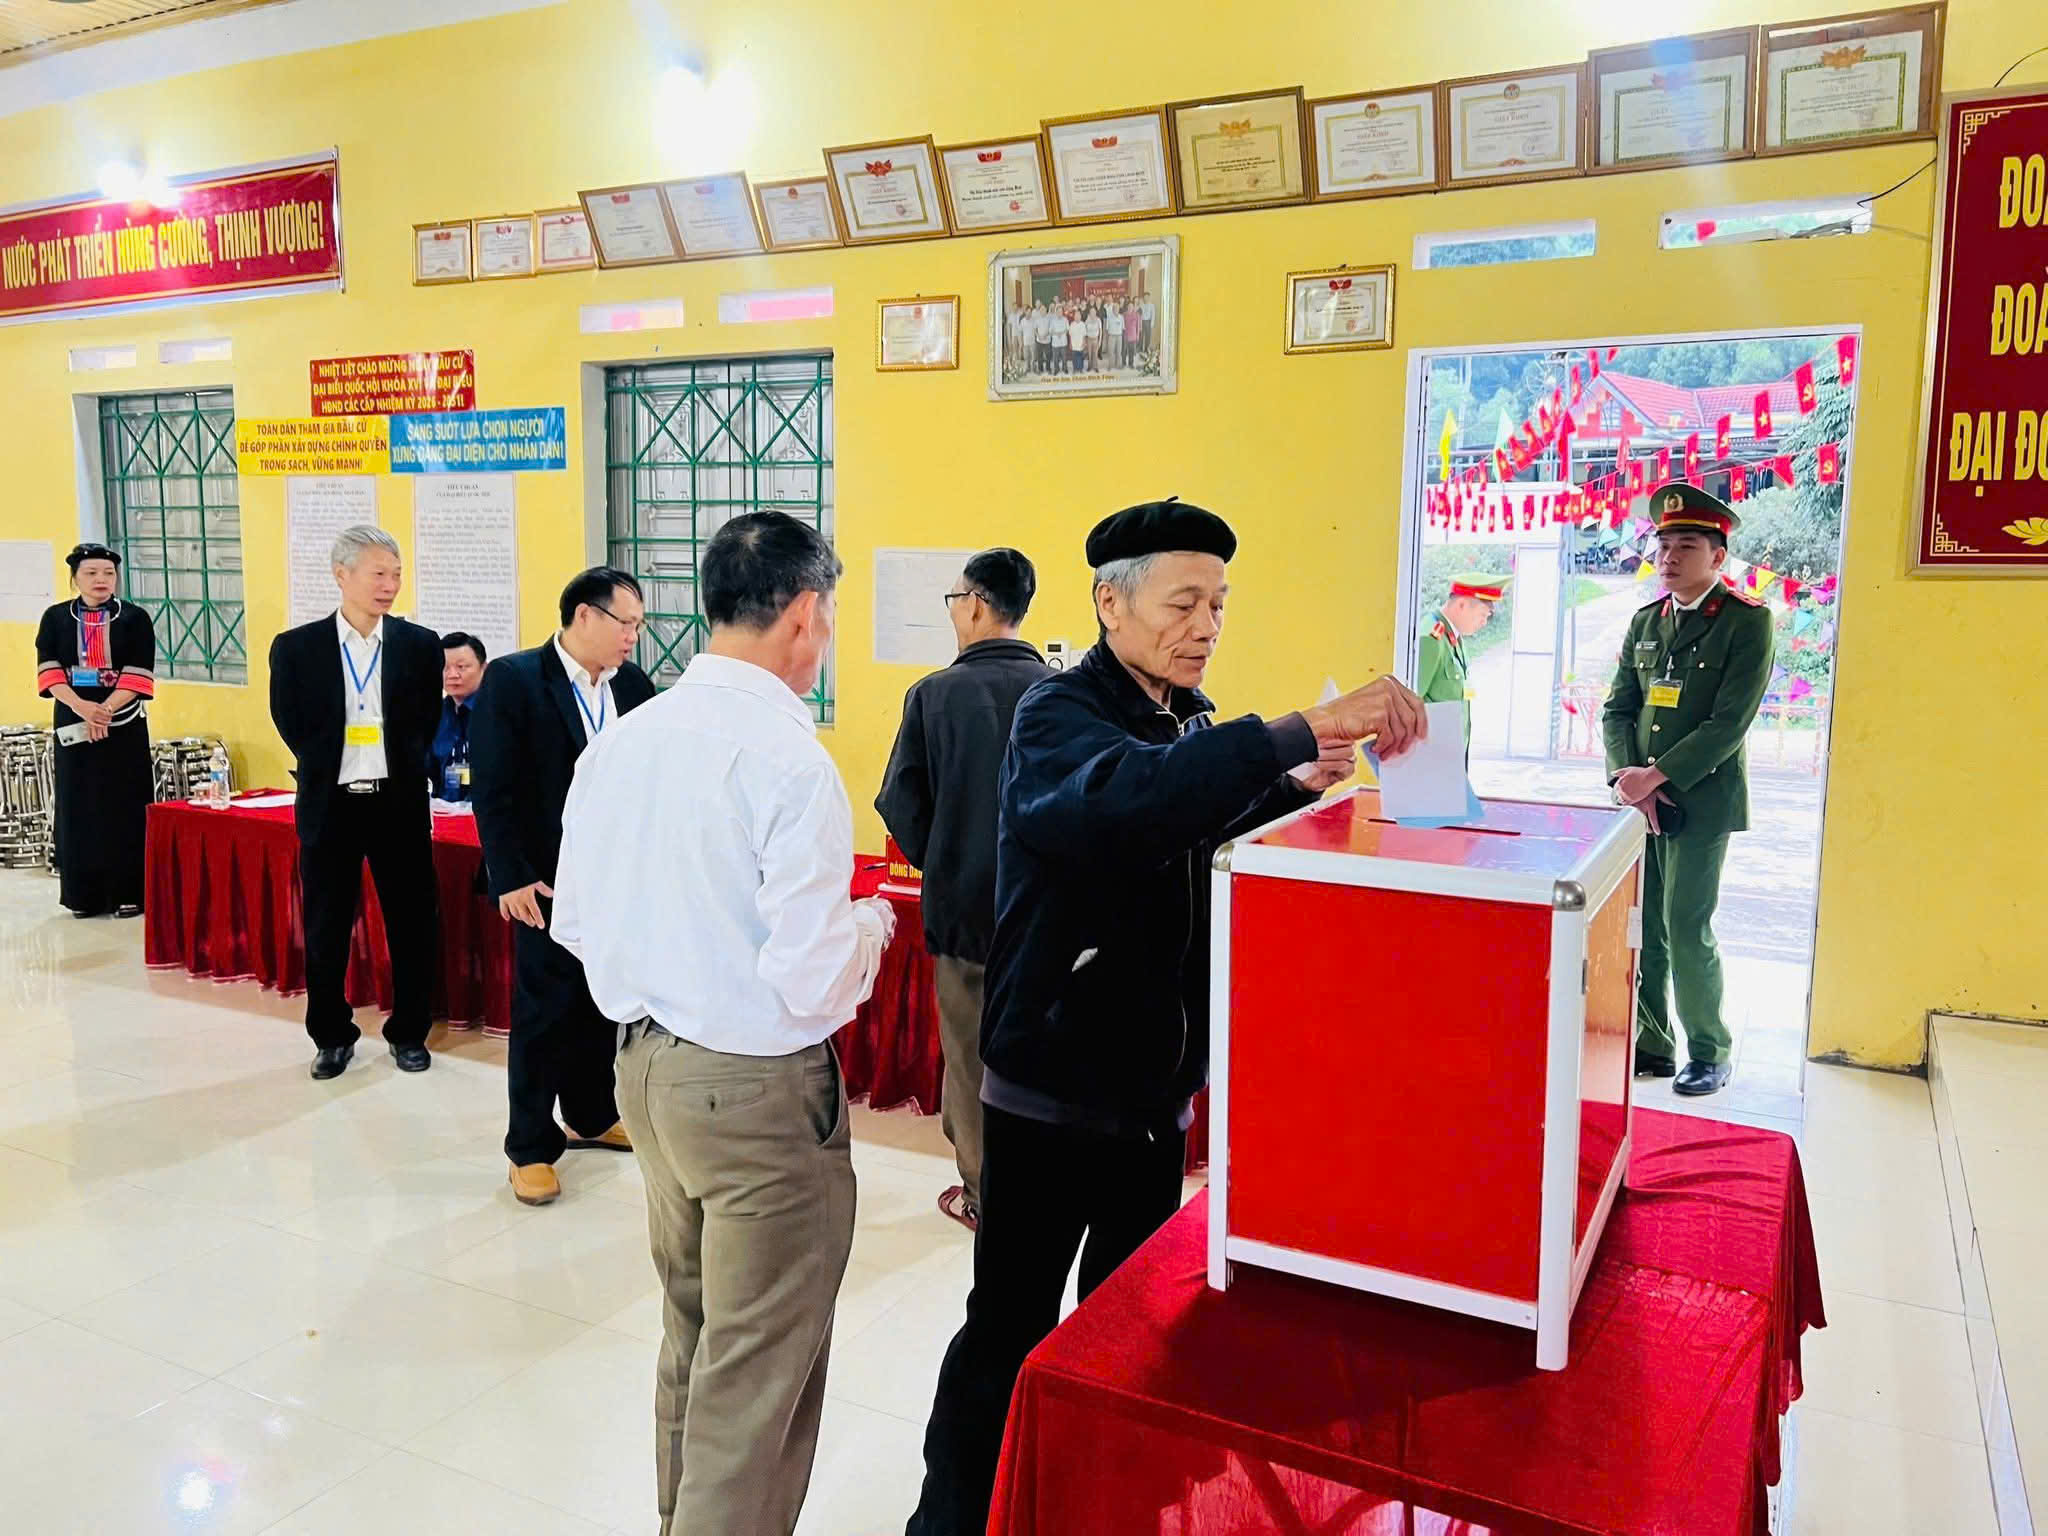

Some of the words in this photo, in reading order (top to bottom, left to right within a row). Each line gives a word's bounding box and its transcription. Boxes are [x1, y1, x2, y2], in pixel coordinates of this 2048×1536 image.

[2000, 154, 2048, 228] ĐO
[2, 235, 37, 290] NƯỚC
[38, 228, 71, 285] PHÁT
[74, 213, 114, 280] TRIỂN
[116, 217, 156, 274] HÙNG
[158, 209, 213, 269] CƯỜNG,
[215, 208, 261, 270] THỊNH
[264, 198, 324, 264] VƯỢNG!
[357, 358, 377, 375] CHÀO
[382, 376, 407, 392] KHÓA
[417, 395, 436, 409] 2026
[299, 423, 320, 435] THAM
[323, 422, 335, 434] GIA
[487, 443, 508, 462] CHO
[1949, 411, 2007, 497] ĐẠI
[260, 459, 286, 471] TRONG
